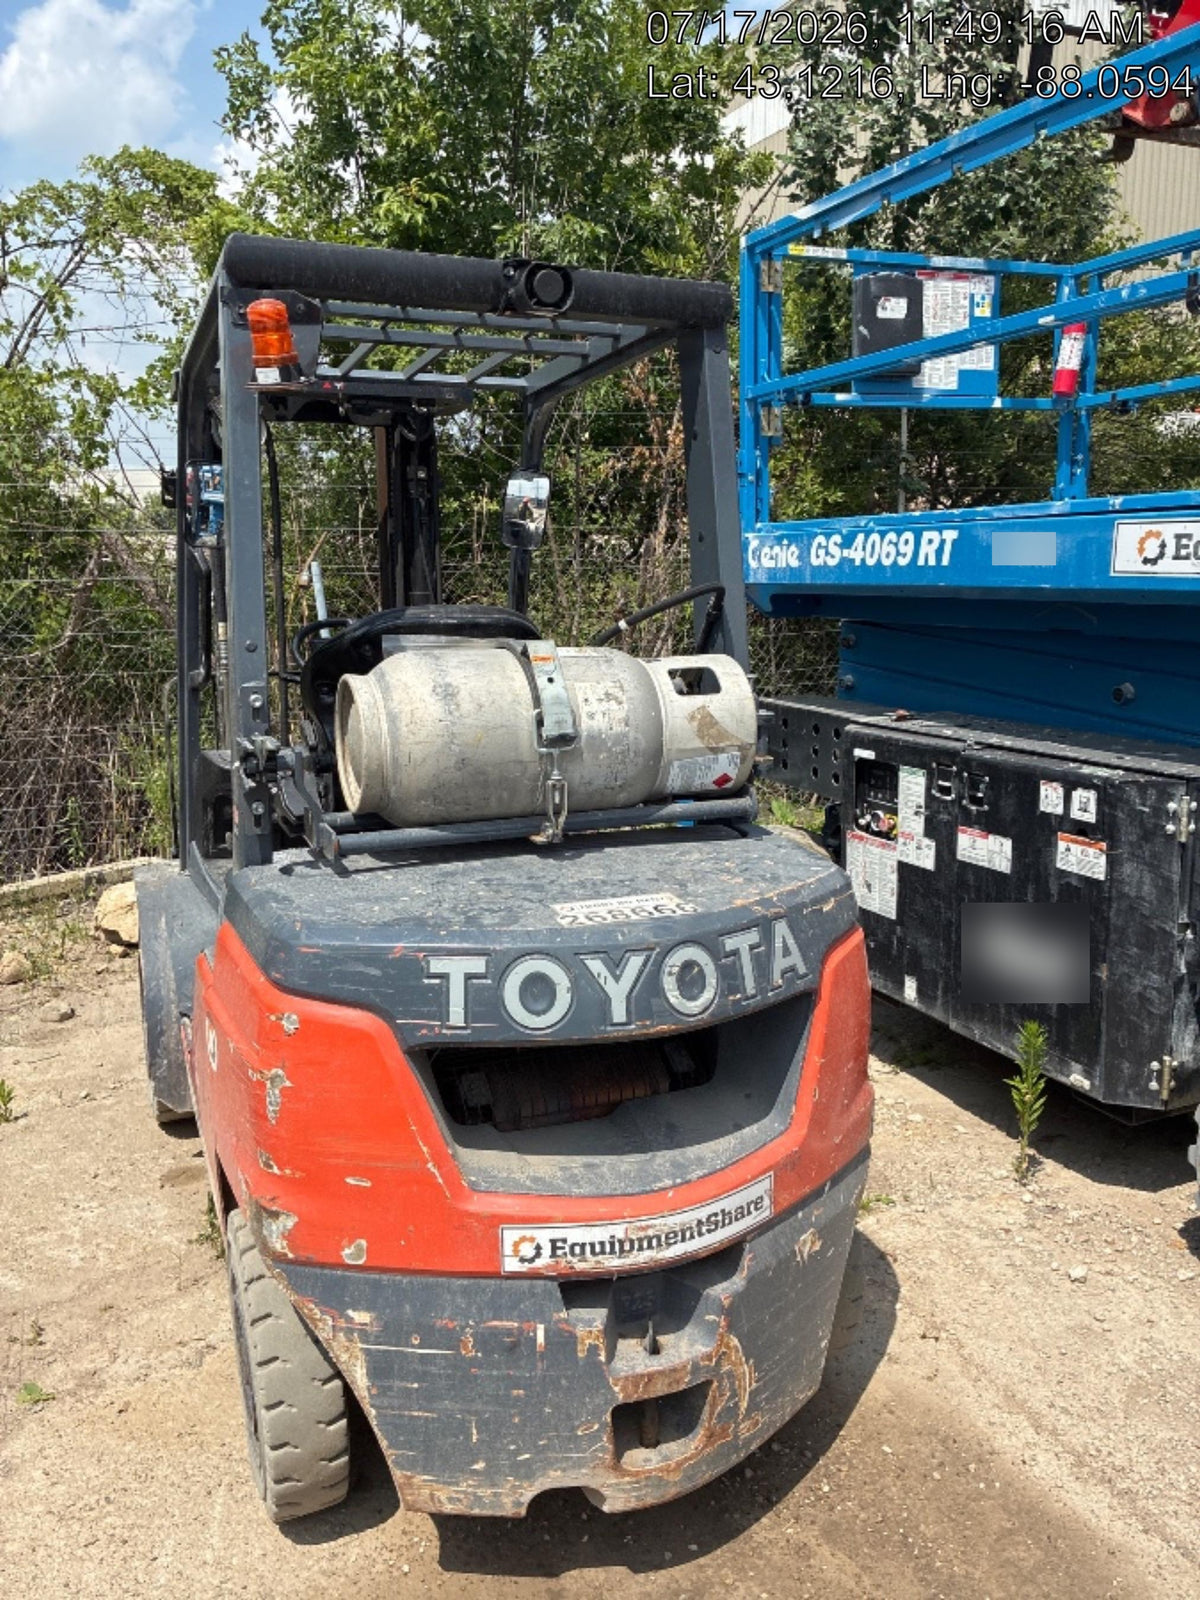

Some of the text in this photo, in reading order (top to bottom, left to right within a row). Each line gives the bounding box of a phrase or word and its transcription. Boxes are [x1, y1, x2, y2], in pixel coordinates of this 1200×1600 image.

[810, 530, 915, 567] GS-4069
[917, 529, 960, 567] RT
[426, 916, 811, 1031] TOYOTA
[549, 1194, 764, 1259] EquipmentShare
